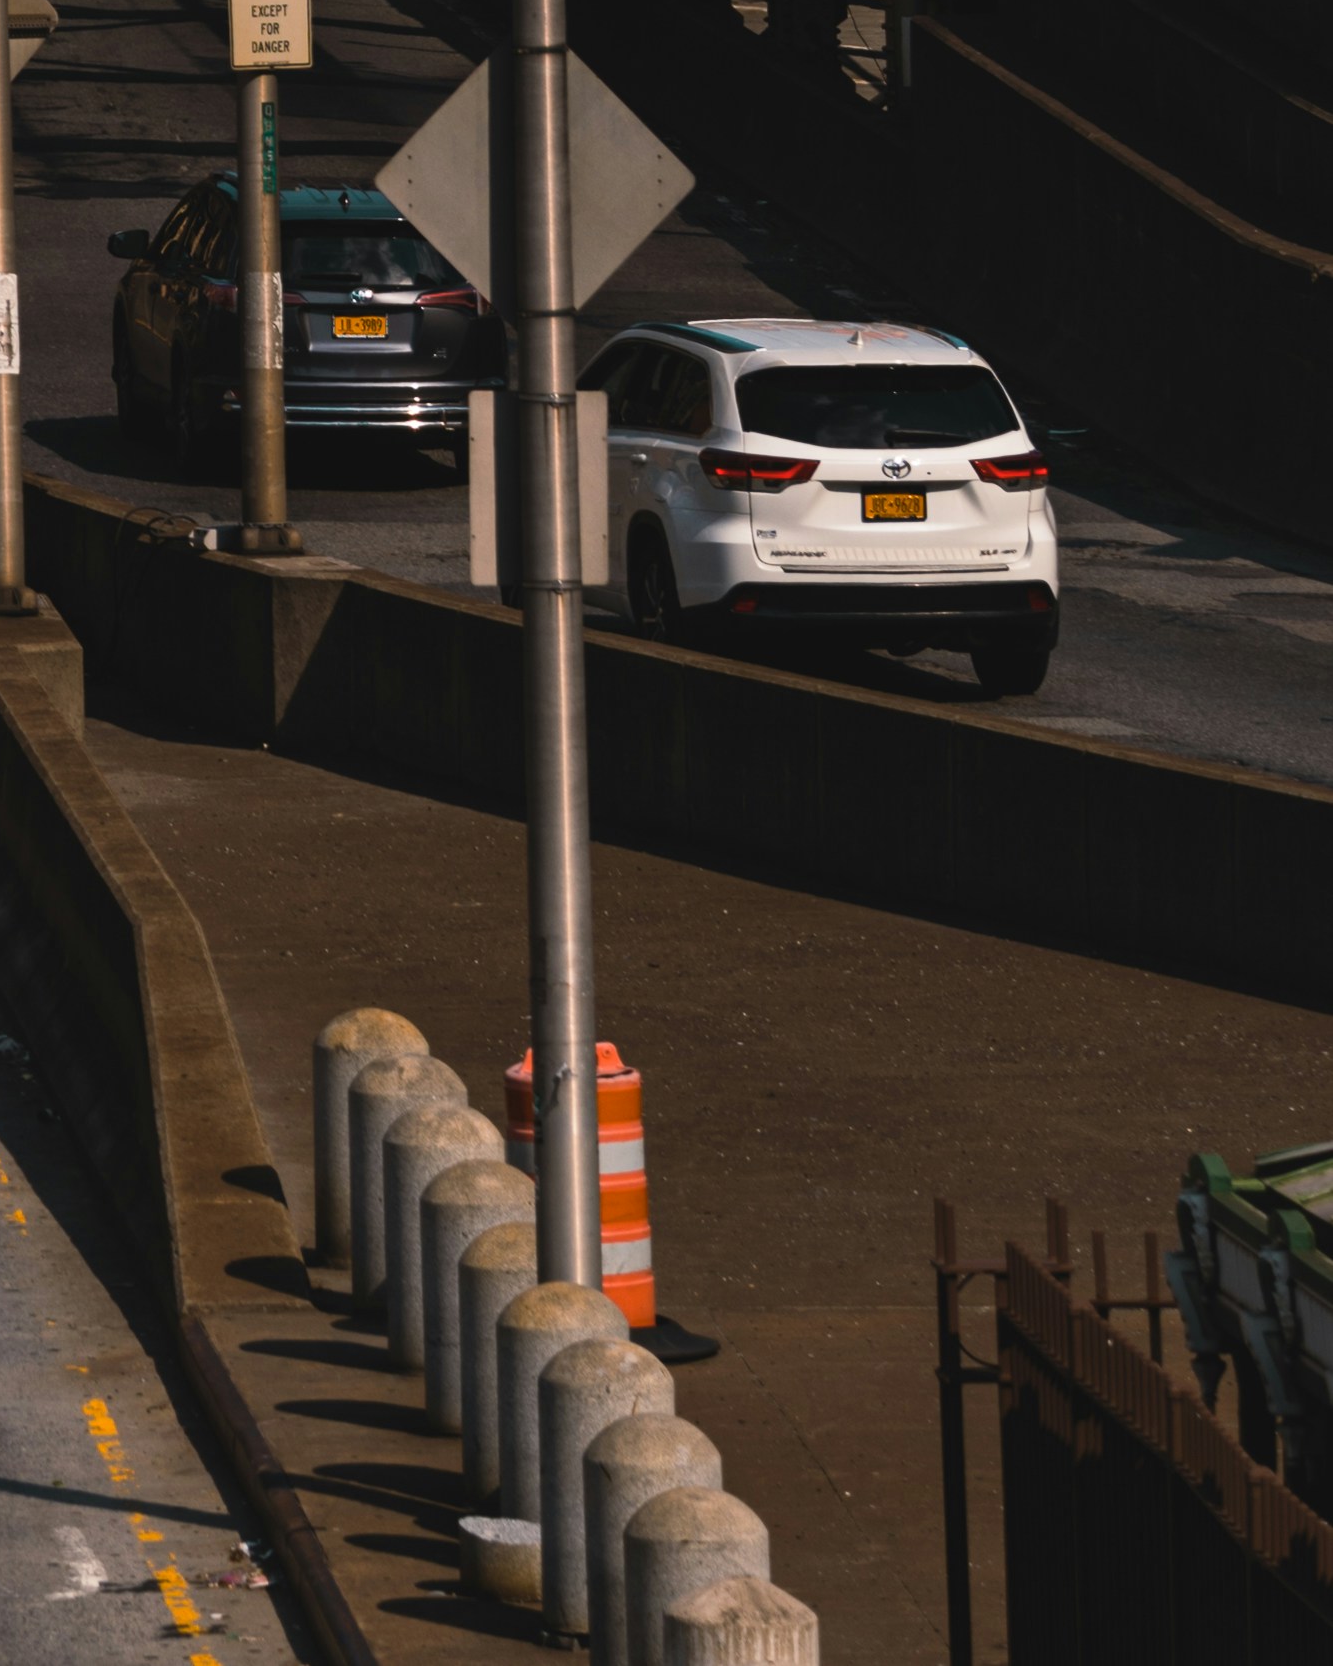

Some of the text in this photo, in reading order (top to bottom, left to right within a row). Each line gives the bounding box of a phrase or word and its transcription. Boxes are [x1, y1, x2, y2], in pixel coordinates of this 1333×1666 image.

[251, 4, 289, 18] EXCEPT
[260, 23, 280, 35] FOR
[252, 41, 291, 54] DANGER
